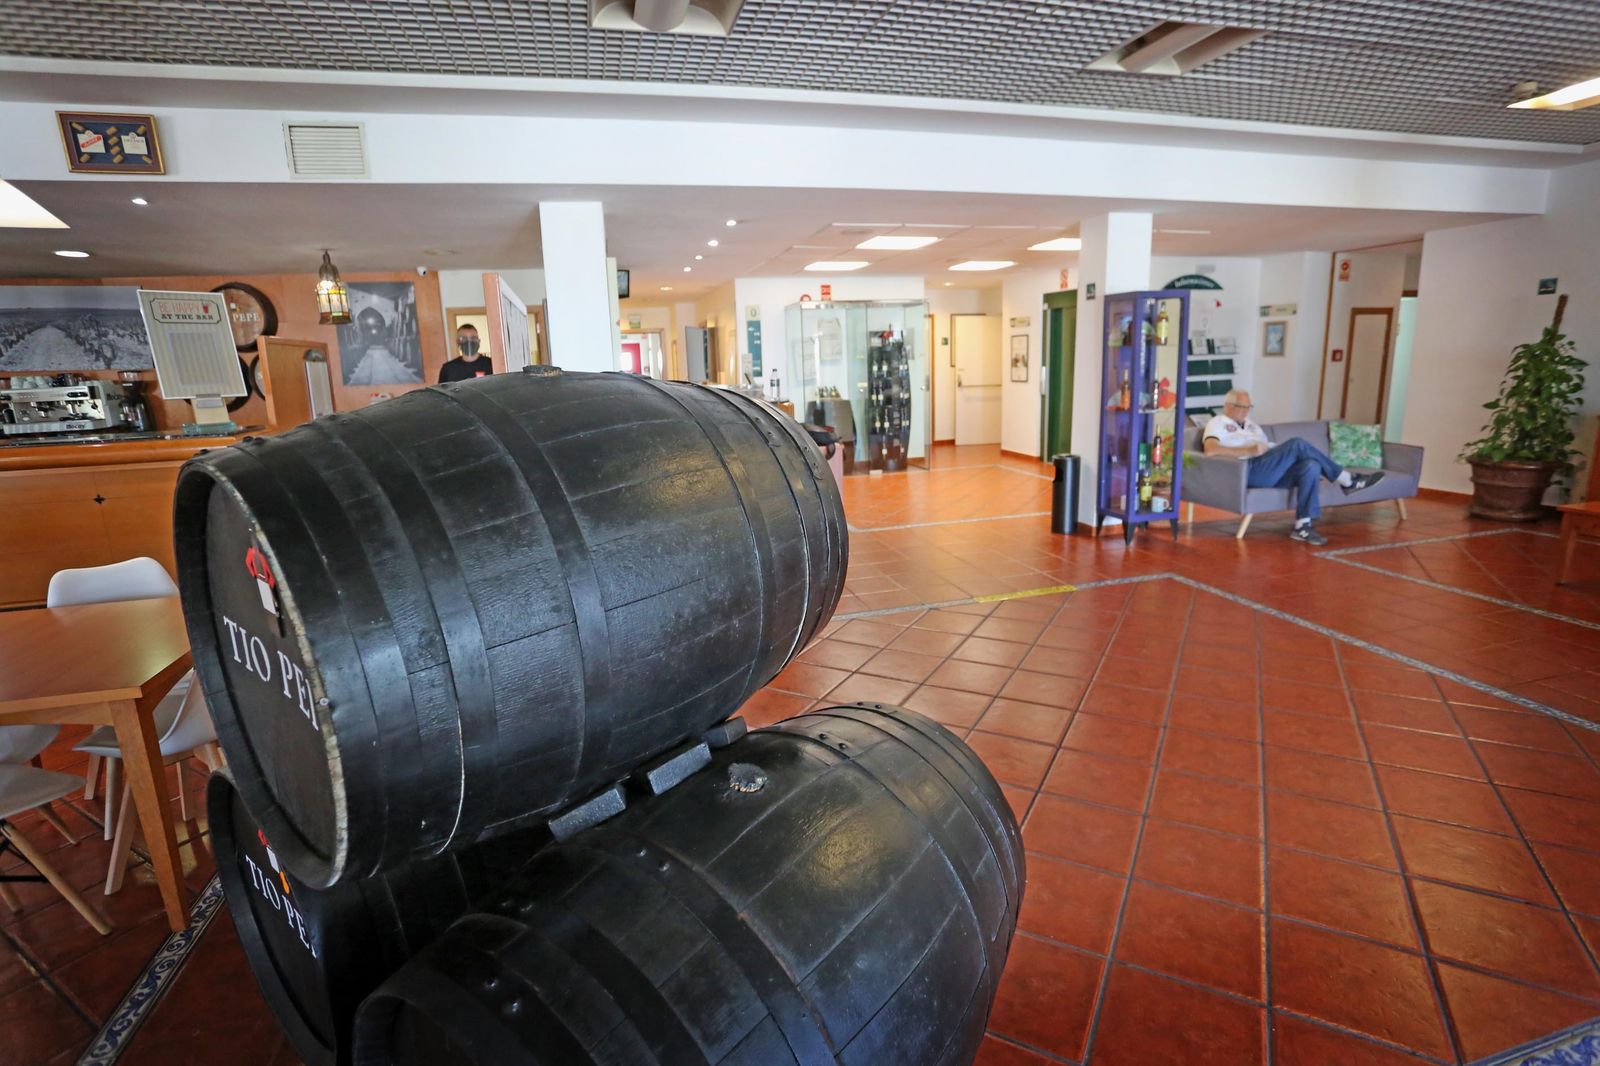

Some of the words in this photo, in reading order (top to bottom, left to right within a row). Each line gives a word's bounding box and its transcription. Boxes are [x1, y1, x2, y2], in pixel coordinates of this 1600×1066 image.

[173, 302, 200, 313] HAPPY
[223, 615, 271, 682] TIO
[245, 854, 281, 911] TIO
[281, 894, 317, 959] PE
